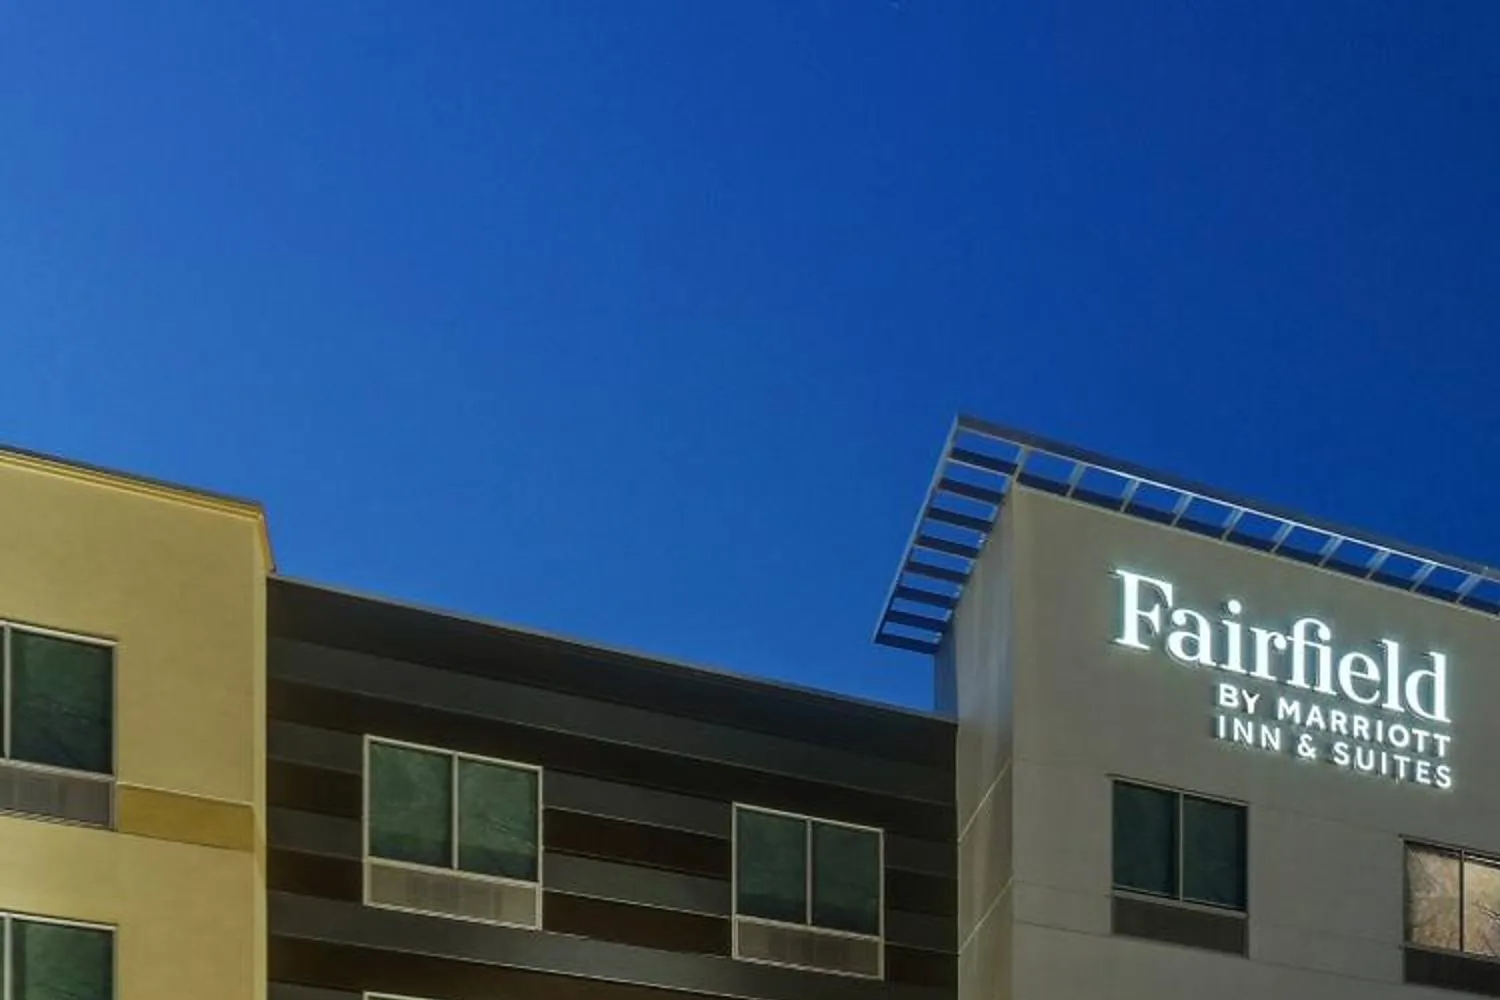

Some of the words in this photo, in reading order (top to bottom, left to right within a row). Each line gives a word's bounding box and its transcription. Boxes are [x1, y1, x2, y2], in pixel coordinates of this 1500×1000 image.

[1114, 568, 1452, 724] Fairfield
[1218, 682, 1261, 715] BY
[1276, 696, 1452, 758] MARRIOTT
[1218, 714, 1281, 751] INN
[1296, 733, 1317, 760] &
[1332, 741, 1453, 790] SUITES
